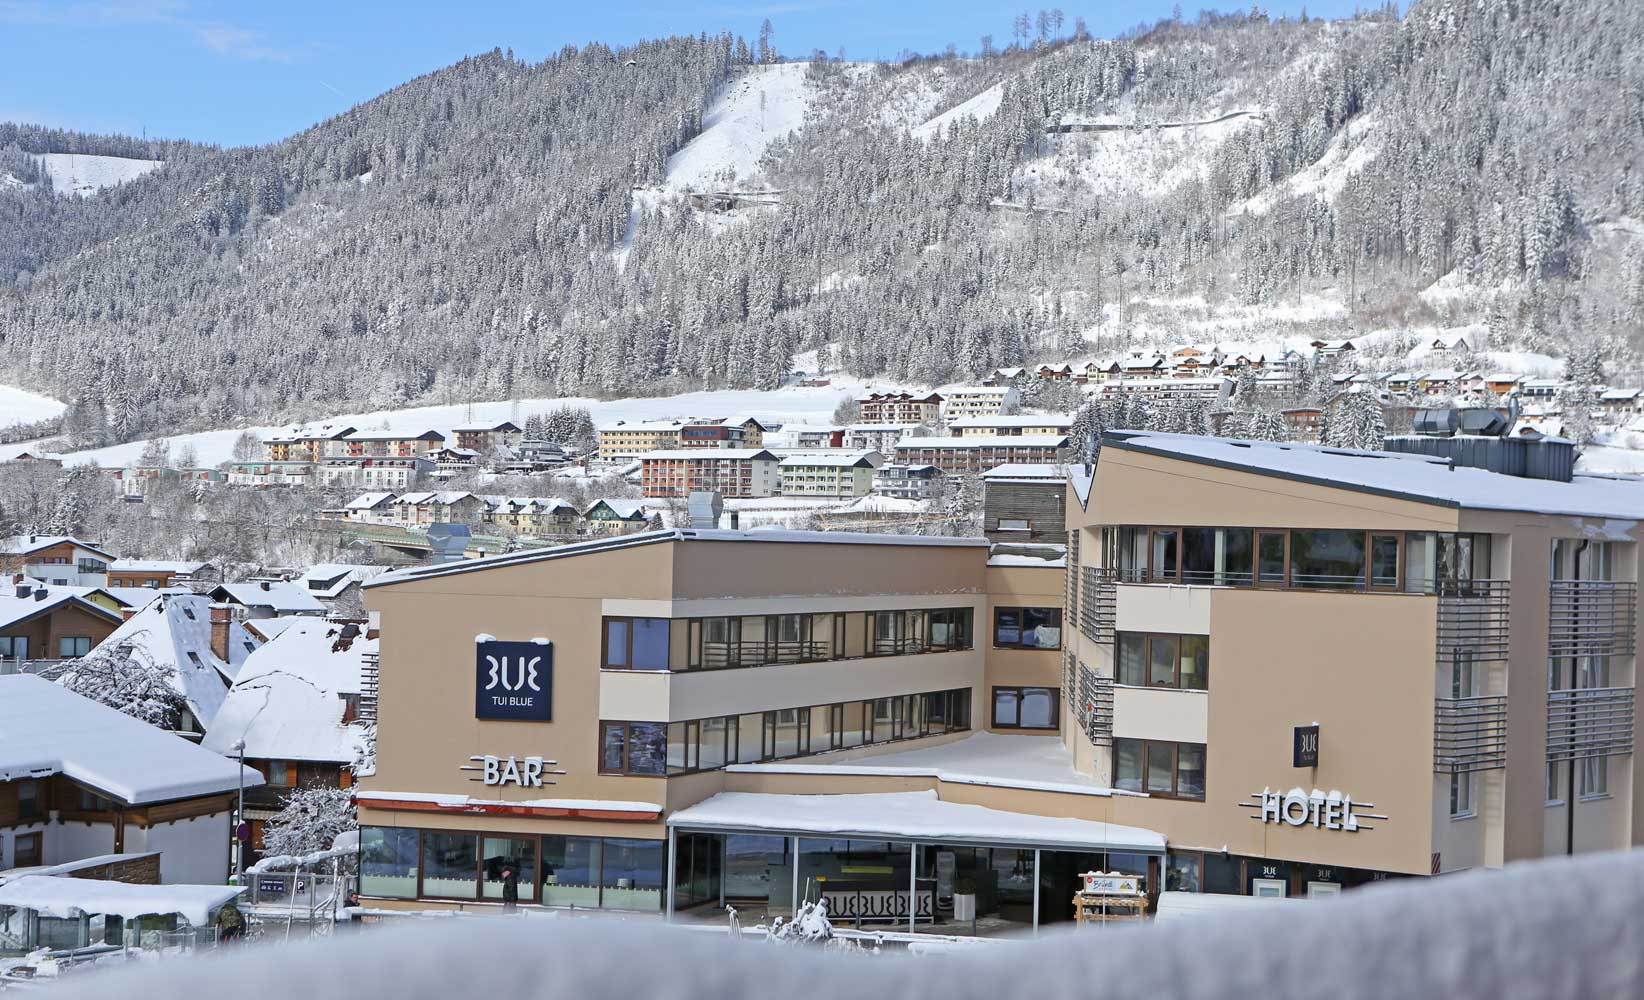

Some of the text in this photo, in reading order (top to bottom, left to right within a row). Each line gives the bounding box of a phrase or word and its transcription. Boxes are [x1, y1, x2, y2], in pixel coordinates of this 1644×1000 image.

[492, 696, 533, 707] TUI BLUE
[483, 756, 543, 787] BAR
[1261, 792, 1358, 832] HOTEL
[297, 881, 304, 890] P
